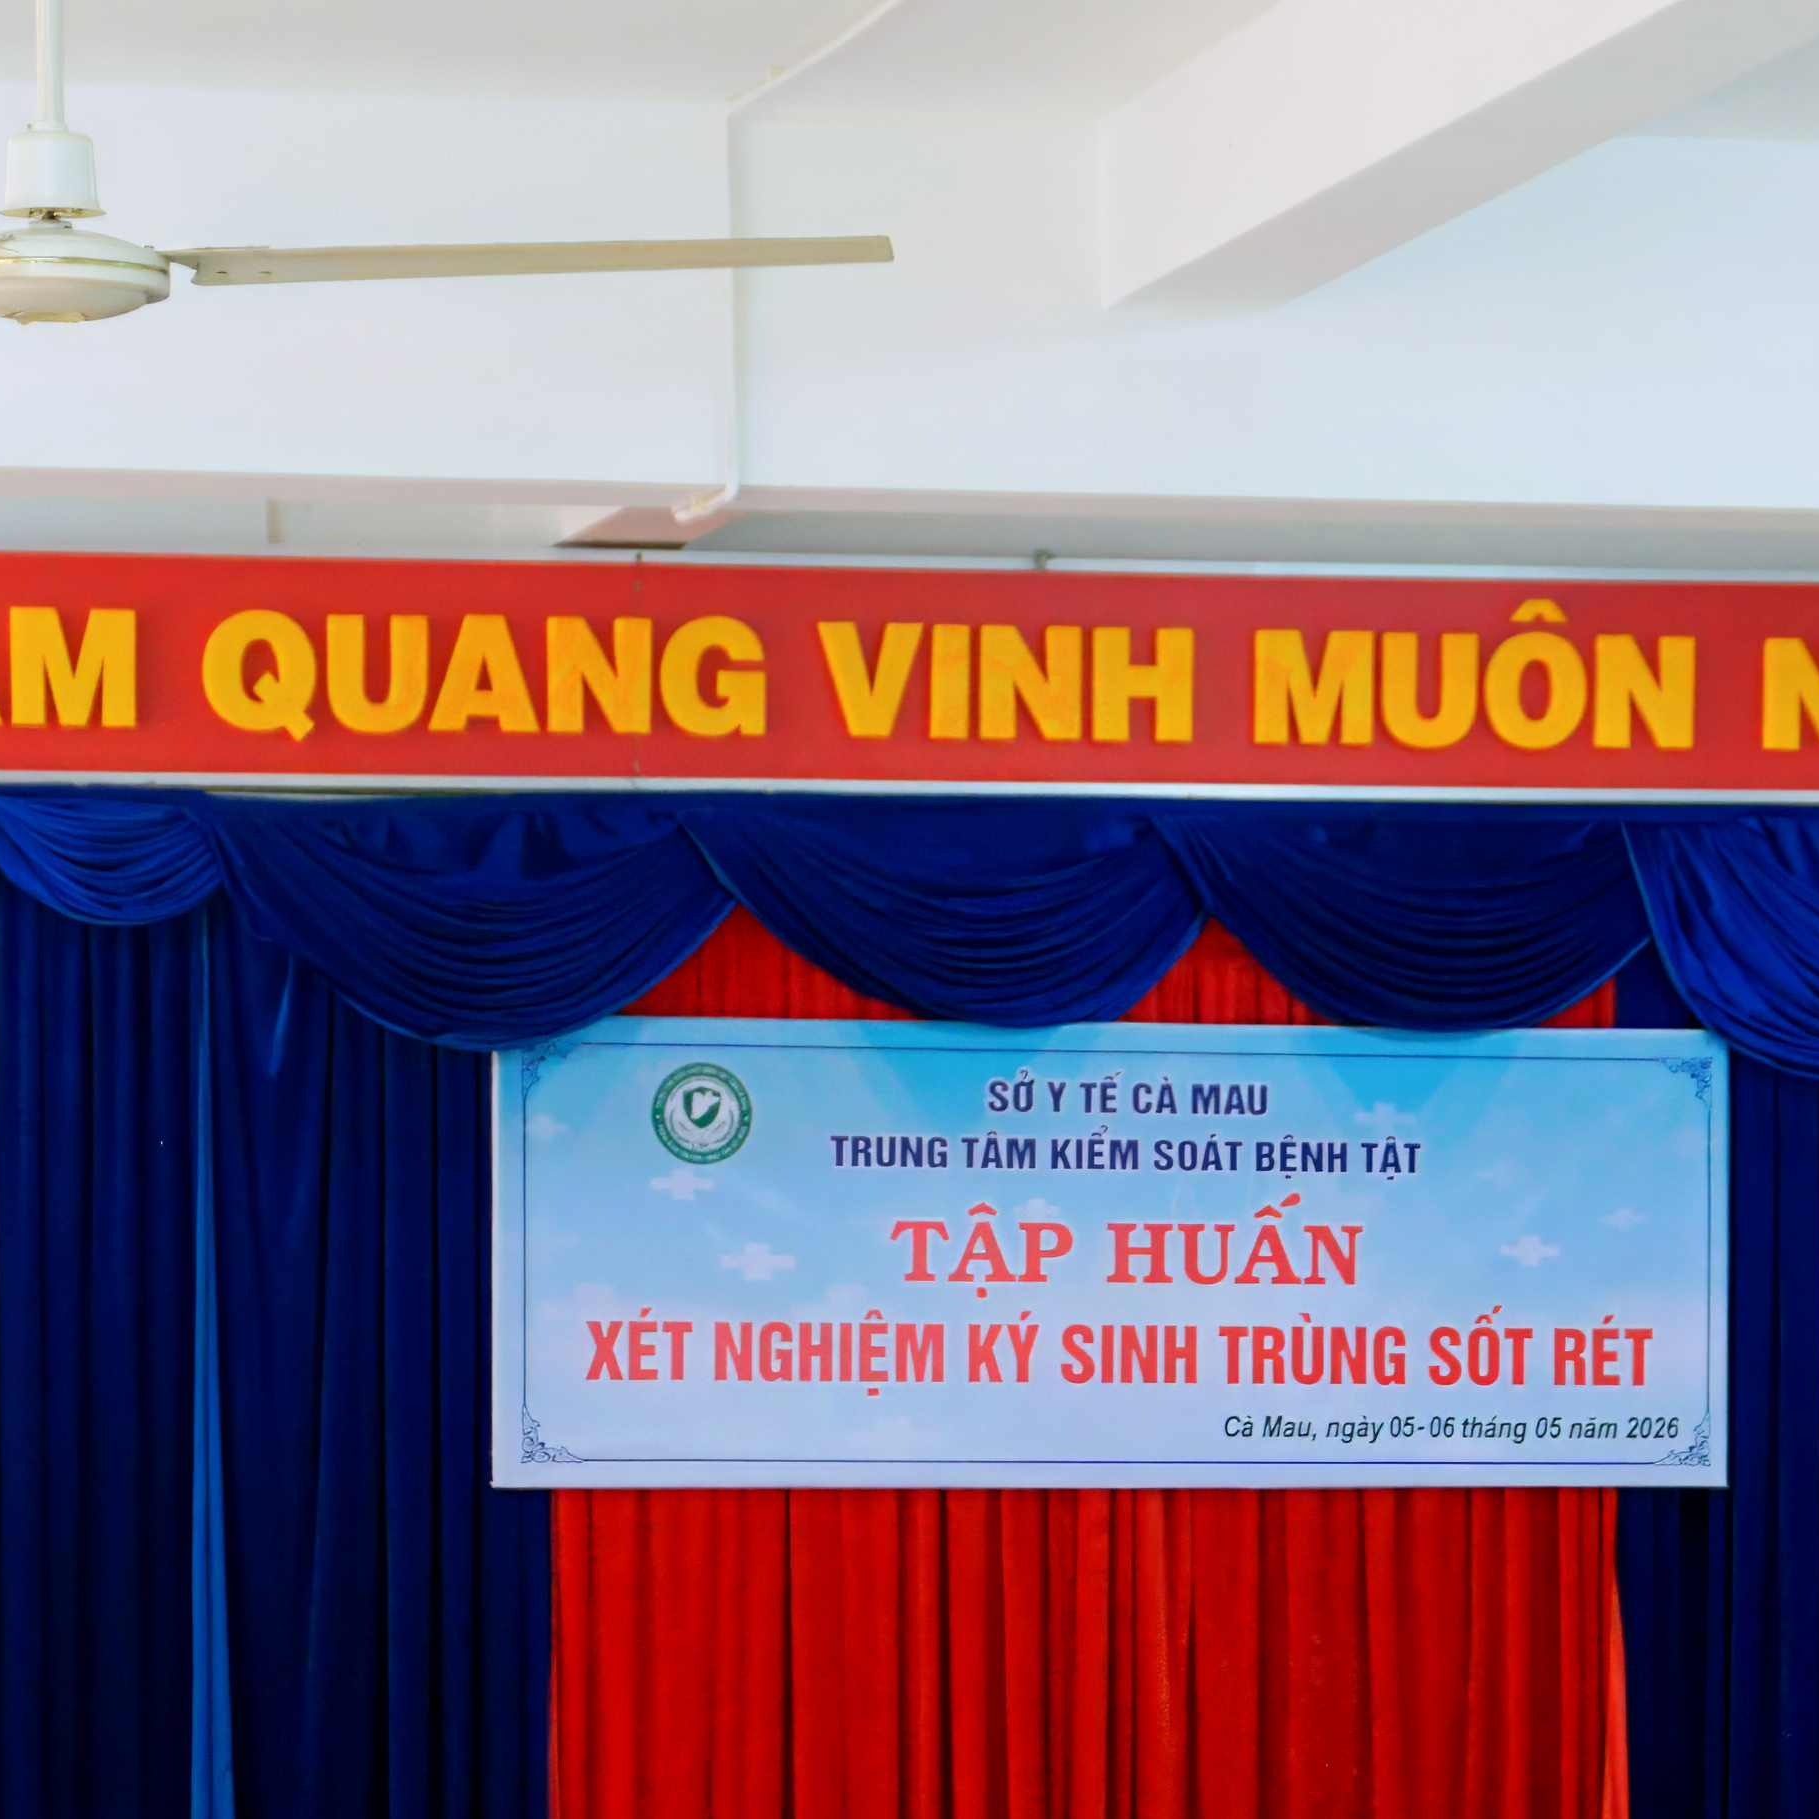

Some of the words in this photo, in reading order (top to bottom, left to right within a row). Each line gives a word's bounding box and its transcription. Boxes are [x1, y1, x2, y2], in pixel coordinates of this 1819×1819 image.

[204, 612, 766, 741] QUANG
[820, 623, 1194, 742] VINH
[1256, 601, 1695, 749] MUÔN
[987, 1069, 1036, 1113] SỞ
[1048, 1081, 1069, 1113] Y
[1080, 1071, 1118, 1115] TẾ
[1132, 1076, 1179, 1115] CÀ
[1191, 1084, 1269, 1116] MAU
[830, 1135, 949, 1169] TRUNG
[961, 1131, 1037, 1170] TÂM
[1051, 1125, 1140, 1171] KIỂM
[1153, 1133, 1244, 1172] SOÁT
[1255, 1134, 1349, 1179] BỆNH
[1361, 1135, 1422, 1181] TẬT
[891, 1202, 1074, 1300] TẬP
[1107, 1193, 1365, 1286] HUẤN
[587, 1309, 693, 1381] XÉT
[716, 1311, 945, 1397] NGHIỆM
[969, 1312, 1040, 1383] KÝ
[1062, 1326, 1198, 1384] SINH
[1220, 1315, 1406, 1386] TRÙNG
[1430, 1307, 1534, 1387] SỐT
[1553, 1315, 1654, 1387] RÉT
[1224, 1415, 1254, 1438] Cà
[1262, 1415, 1317, 1440] Mau,
[1324, 1414, 1385, 1444] ngày
[1462, 1416, 1527, 1445] tháng
[1535, 1416, 1561, 1439] 05
[1568, 1415, 1619, 1440] năm
[1626, 1416, 1678, 1439] 2026
